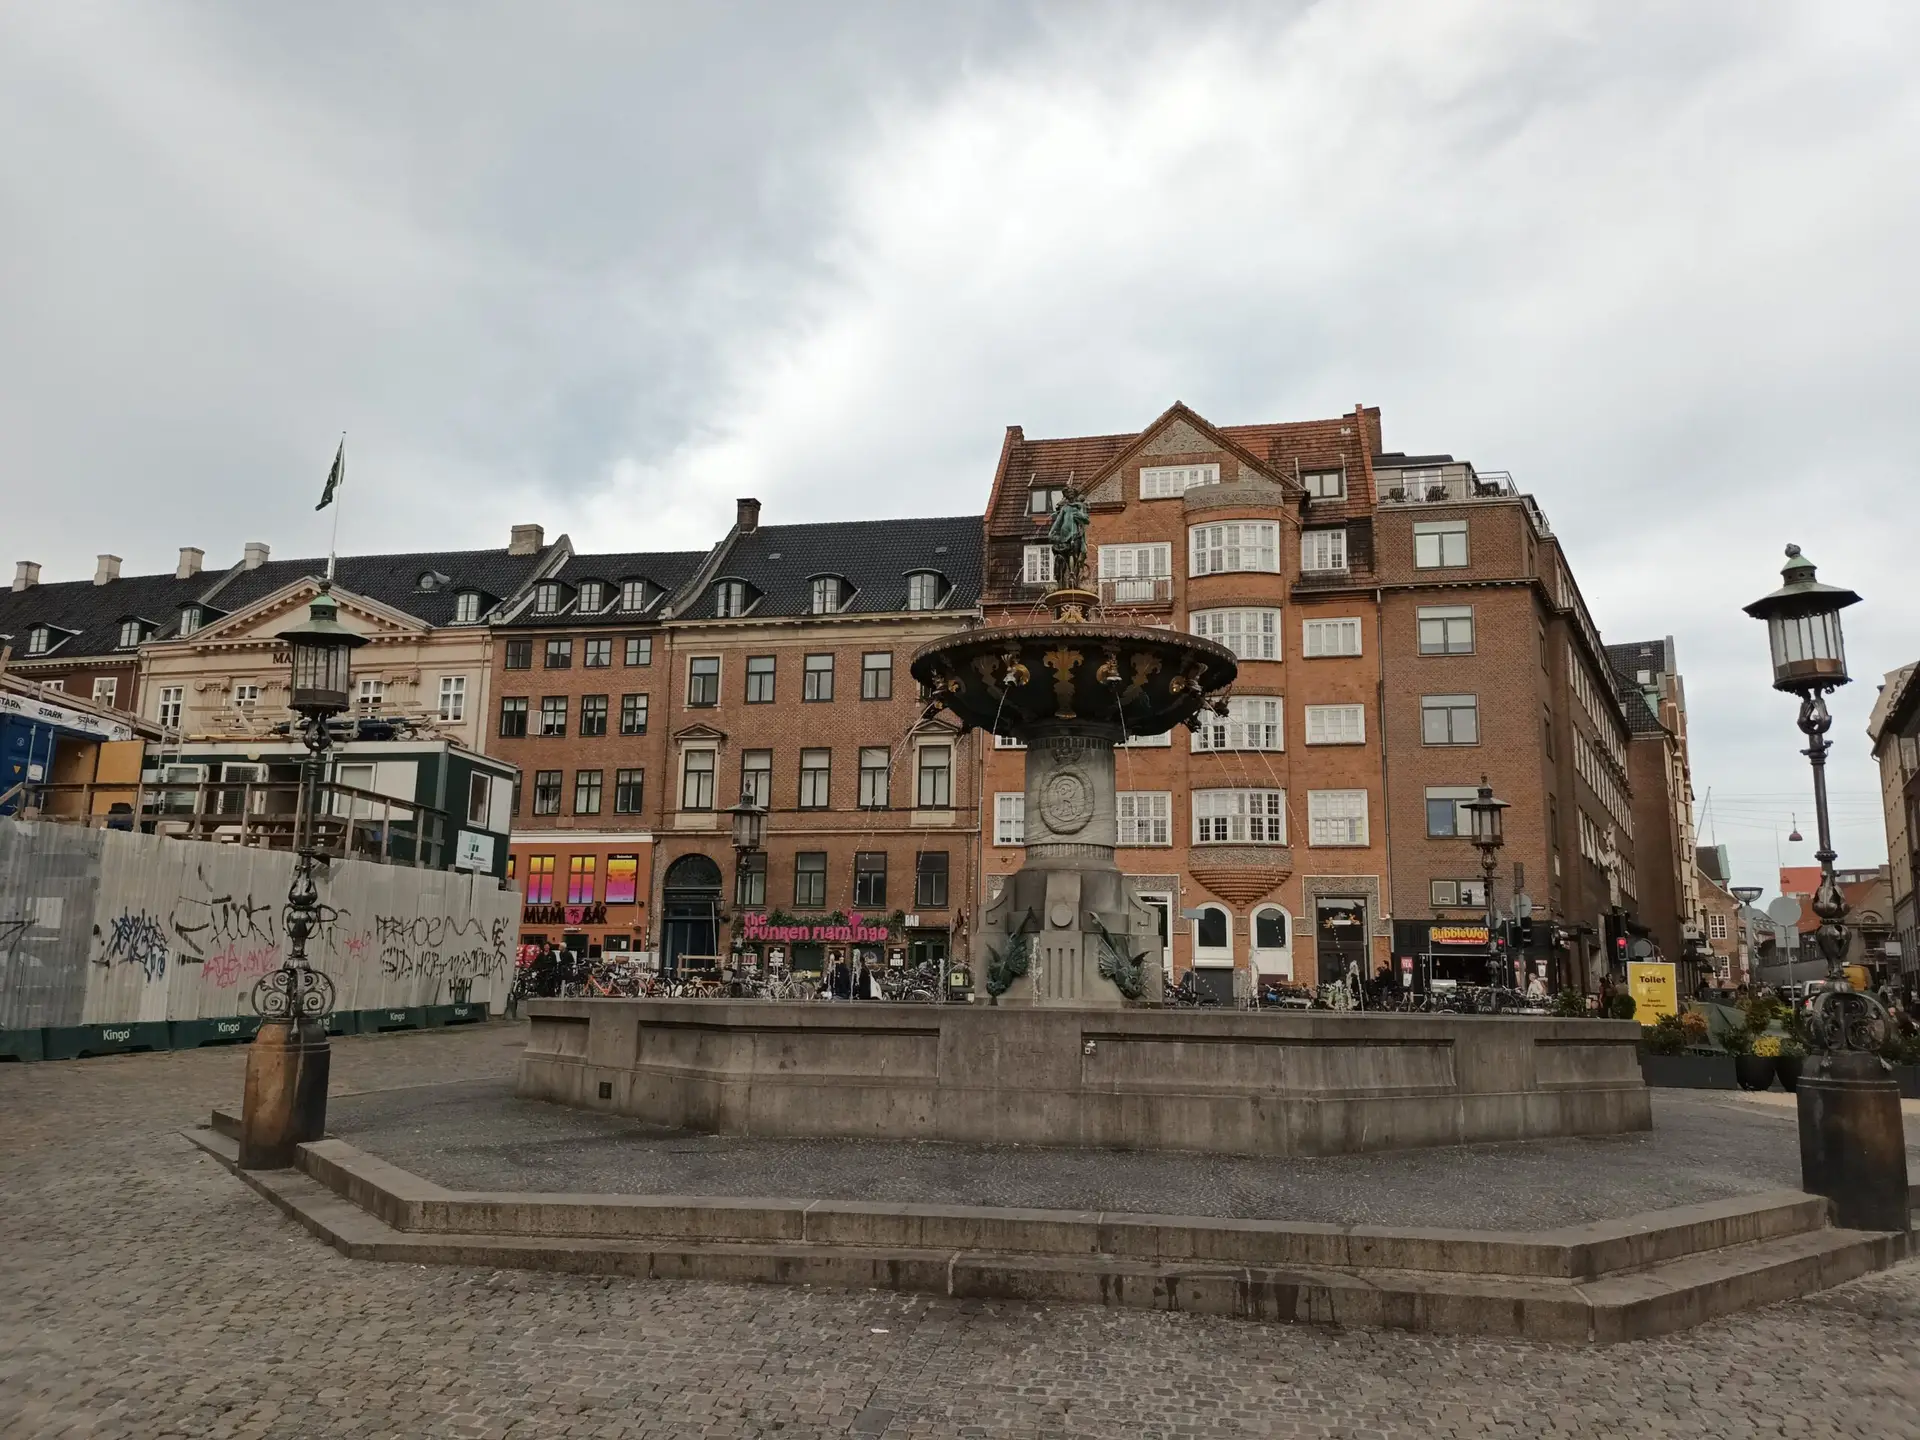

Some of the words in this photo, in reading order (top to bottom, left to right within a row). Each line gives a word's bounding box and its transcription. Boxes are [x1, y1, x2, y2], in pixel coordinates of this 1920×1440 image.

[38, 707, 63, 719] STARK
[77, 715, 100, 728] STARK
[523, 906, 565, 924] MIAMI
[581, 905, 608, 924] BAR
[390, 1012, 405, 1022] Kingo
[454, 1007, 468, 1017] Kingo
[218, 1021, 240, 1033] Kingo
[103, 1028, 130, 1042] Kingo
